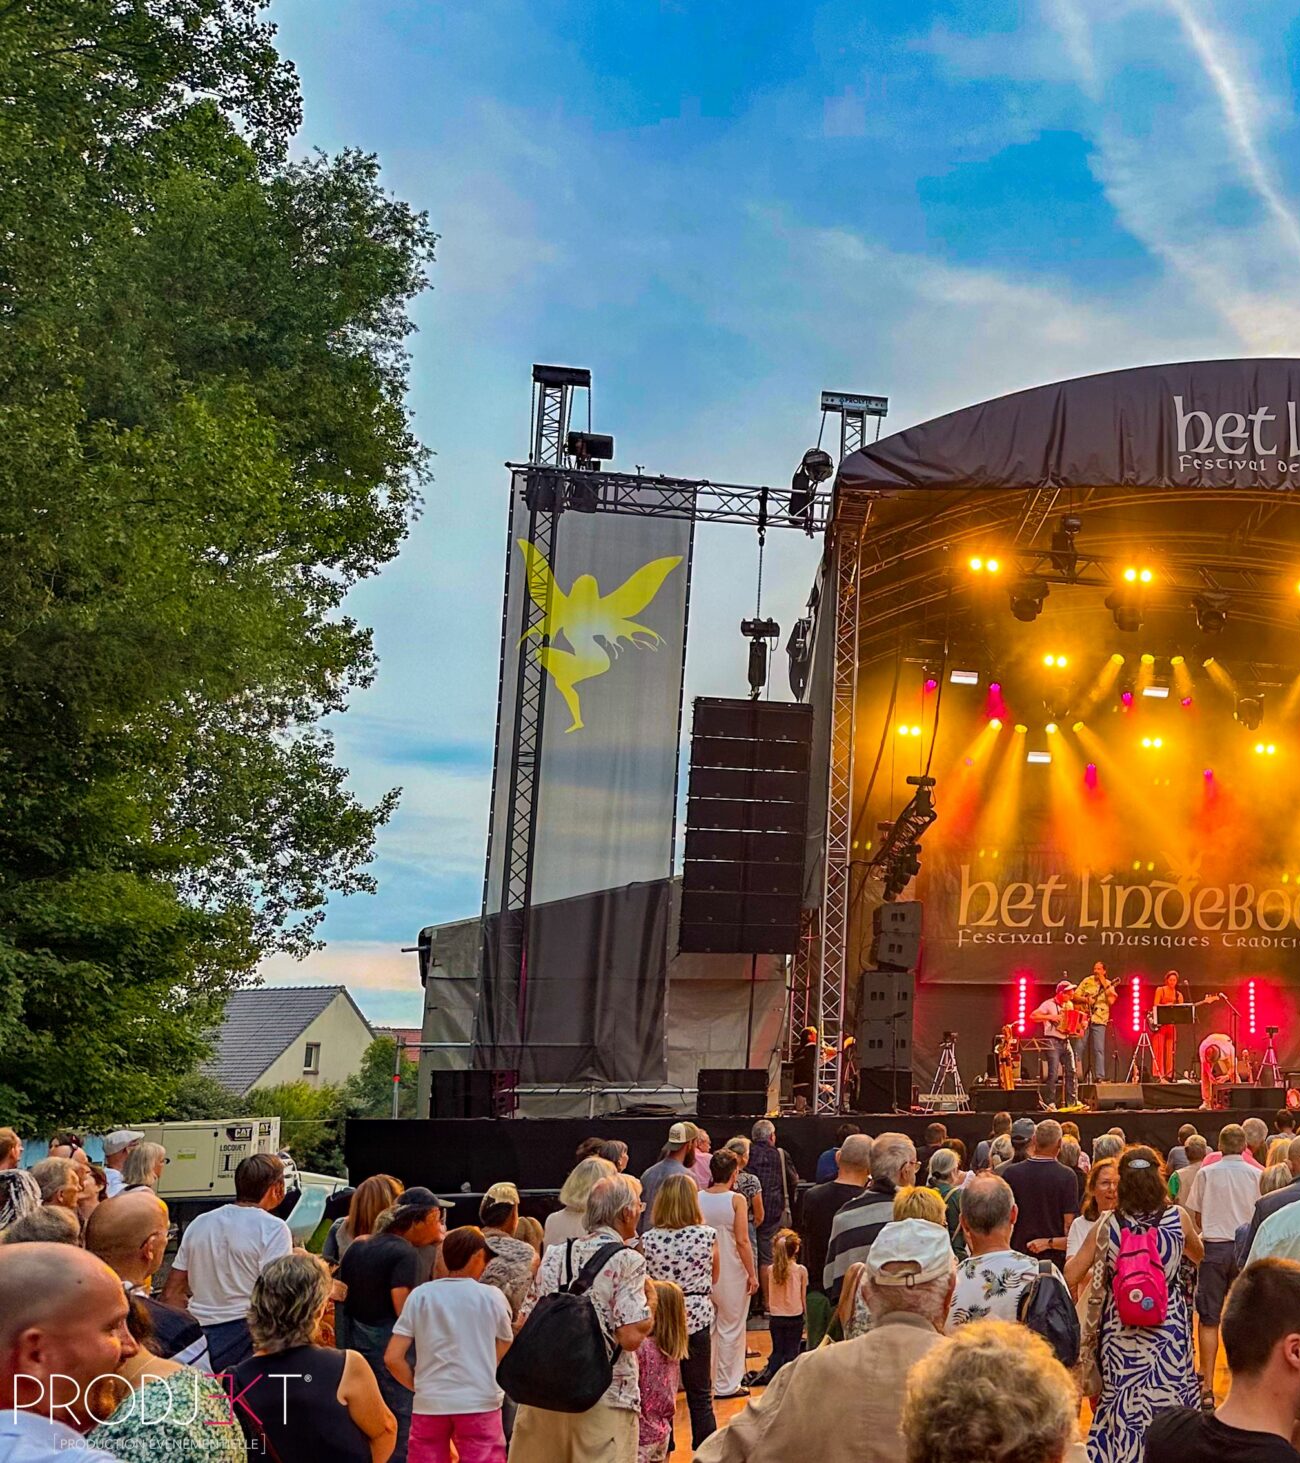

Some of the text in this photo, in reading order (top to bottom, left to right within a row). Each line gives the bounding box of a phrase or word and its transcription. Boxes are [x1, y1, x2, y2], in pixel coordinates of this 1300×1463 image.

[1173, 395, 1278, 456] het
[1178, 454, 1267, 473] Festival
[1277, 459, 1300, 474] de
[957, 864, 1068, 928] het
[957, 928, 1052, 948] Festival
[1064, 930, 1088, 945] de
[1100, 931, 1210, 948] Musiques
[235, 1128, 251, 1138] CAT
